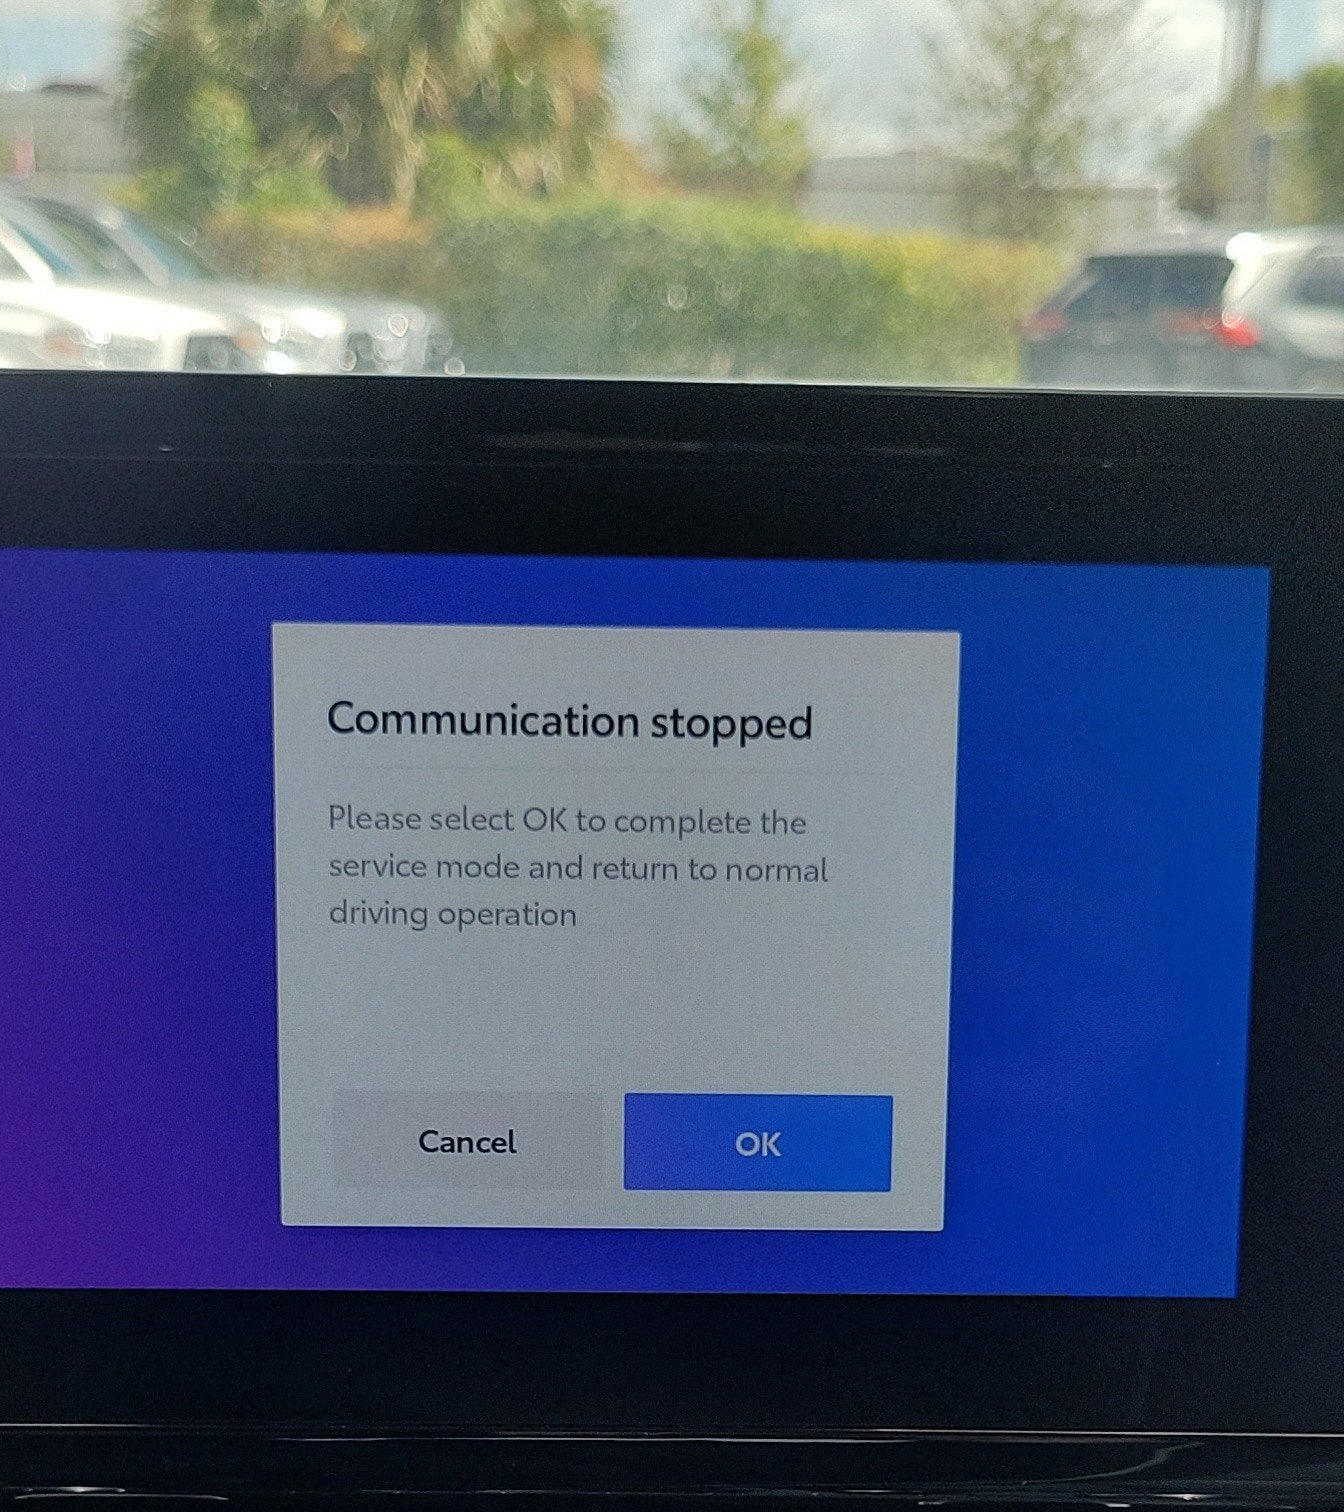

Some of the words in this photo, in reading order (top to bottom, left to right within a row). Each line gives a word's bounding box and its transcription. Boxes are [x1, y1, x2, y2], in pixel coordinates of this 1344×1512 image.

[327, 700, 640, 739] Communication
[650, 705, 814, 749] stopped
[329, 803, 422, 833] Please
[429, 805, 515, 833] select
[522, 807, 568, 833] OK
[575, 810, 607, 834] to
[614, 808, 752, 843] complete
[759, 809, 807, 836] the
[329, 854, 427, 879] service
[436, 853, 520, 880] mode
[528, 855, 583, 881] and
[591, 859, 679, 882] return
[687, 858, 718, 883] to
[725, 857, 829, 883] normal
[329, 900, 429, 932] driving
[437, 902, 578, 933] operation
[417, 1129, 517, 1157] Cancel
[734, 1131, 783, 1159] OK
